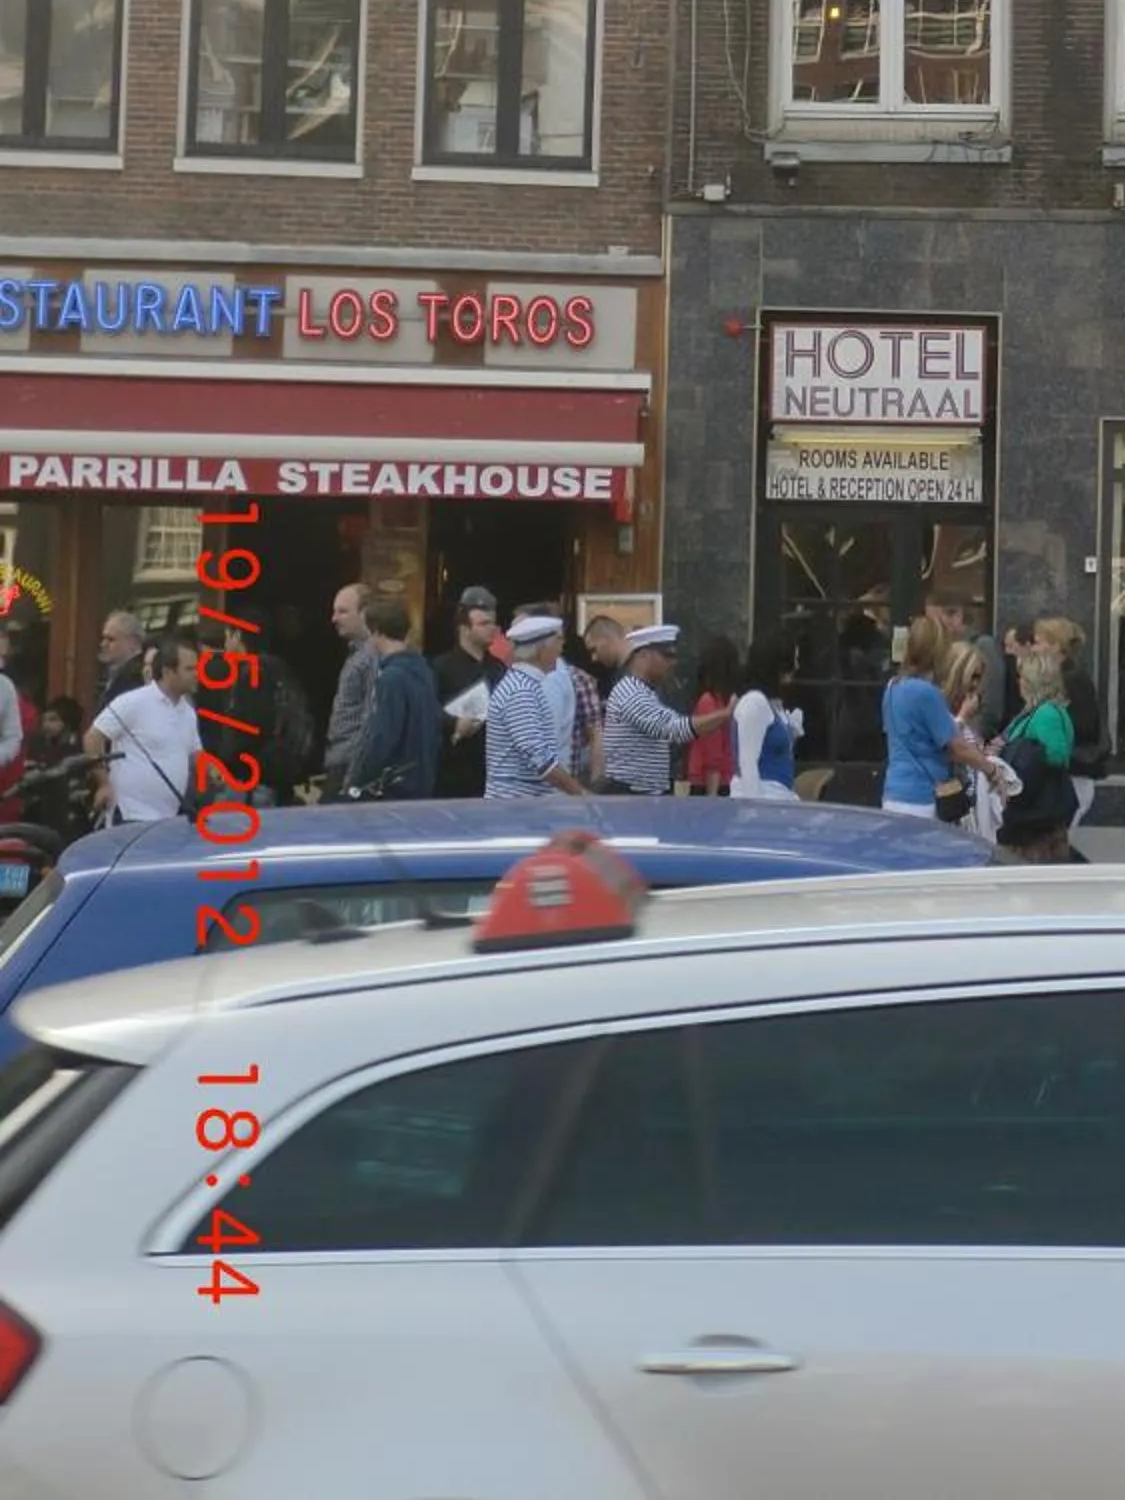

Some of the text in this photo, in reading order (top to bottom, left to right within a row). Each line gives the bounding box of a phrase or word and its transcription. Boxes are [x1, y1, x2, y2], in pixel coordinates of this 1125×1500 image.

[299, 289, 399, 341] LOS
[418, 291, 595, 349] TOROS
[785, 329, 980, 380] HOTEL
[784, 386, 980, 418] NEUTRAAL
[9, 454, 613, 499] PARRILLA STEAKHOUSE
[799, 450, 949, 471] ROOMS AVAILABLE
[769, 475, 812, 499] HOTEL
[817, 477, 826, 500] &
[829, 476, 906, 500] RECEPTION
[908, 479, 944, 501] OPEN
[947, 480, 962, 501] 24
